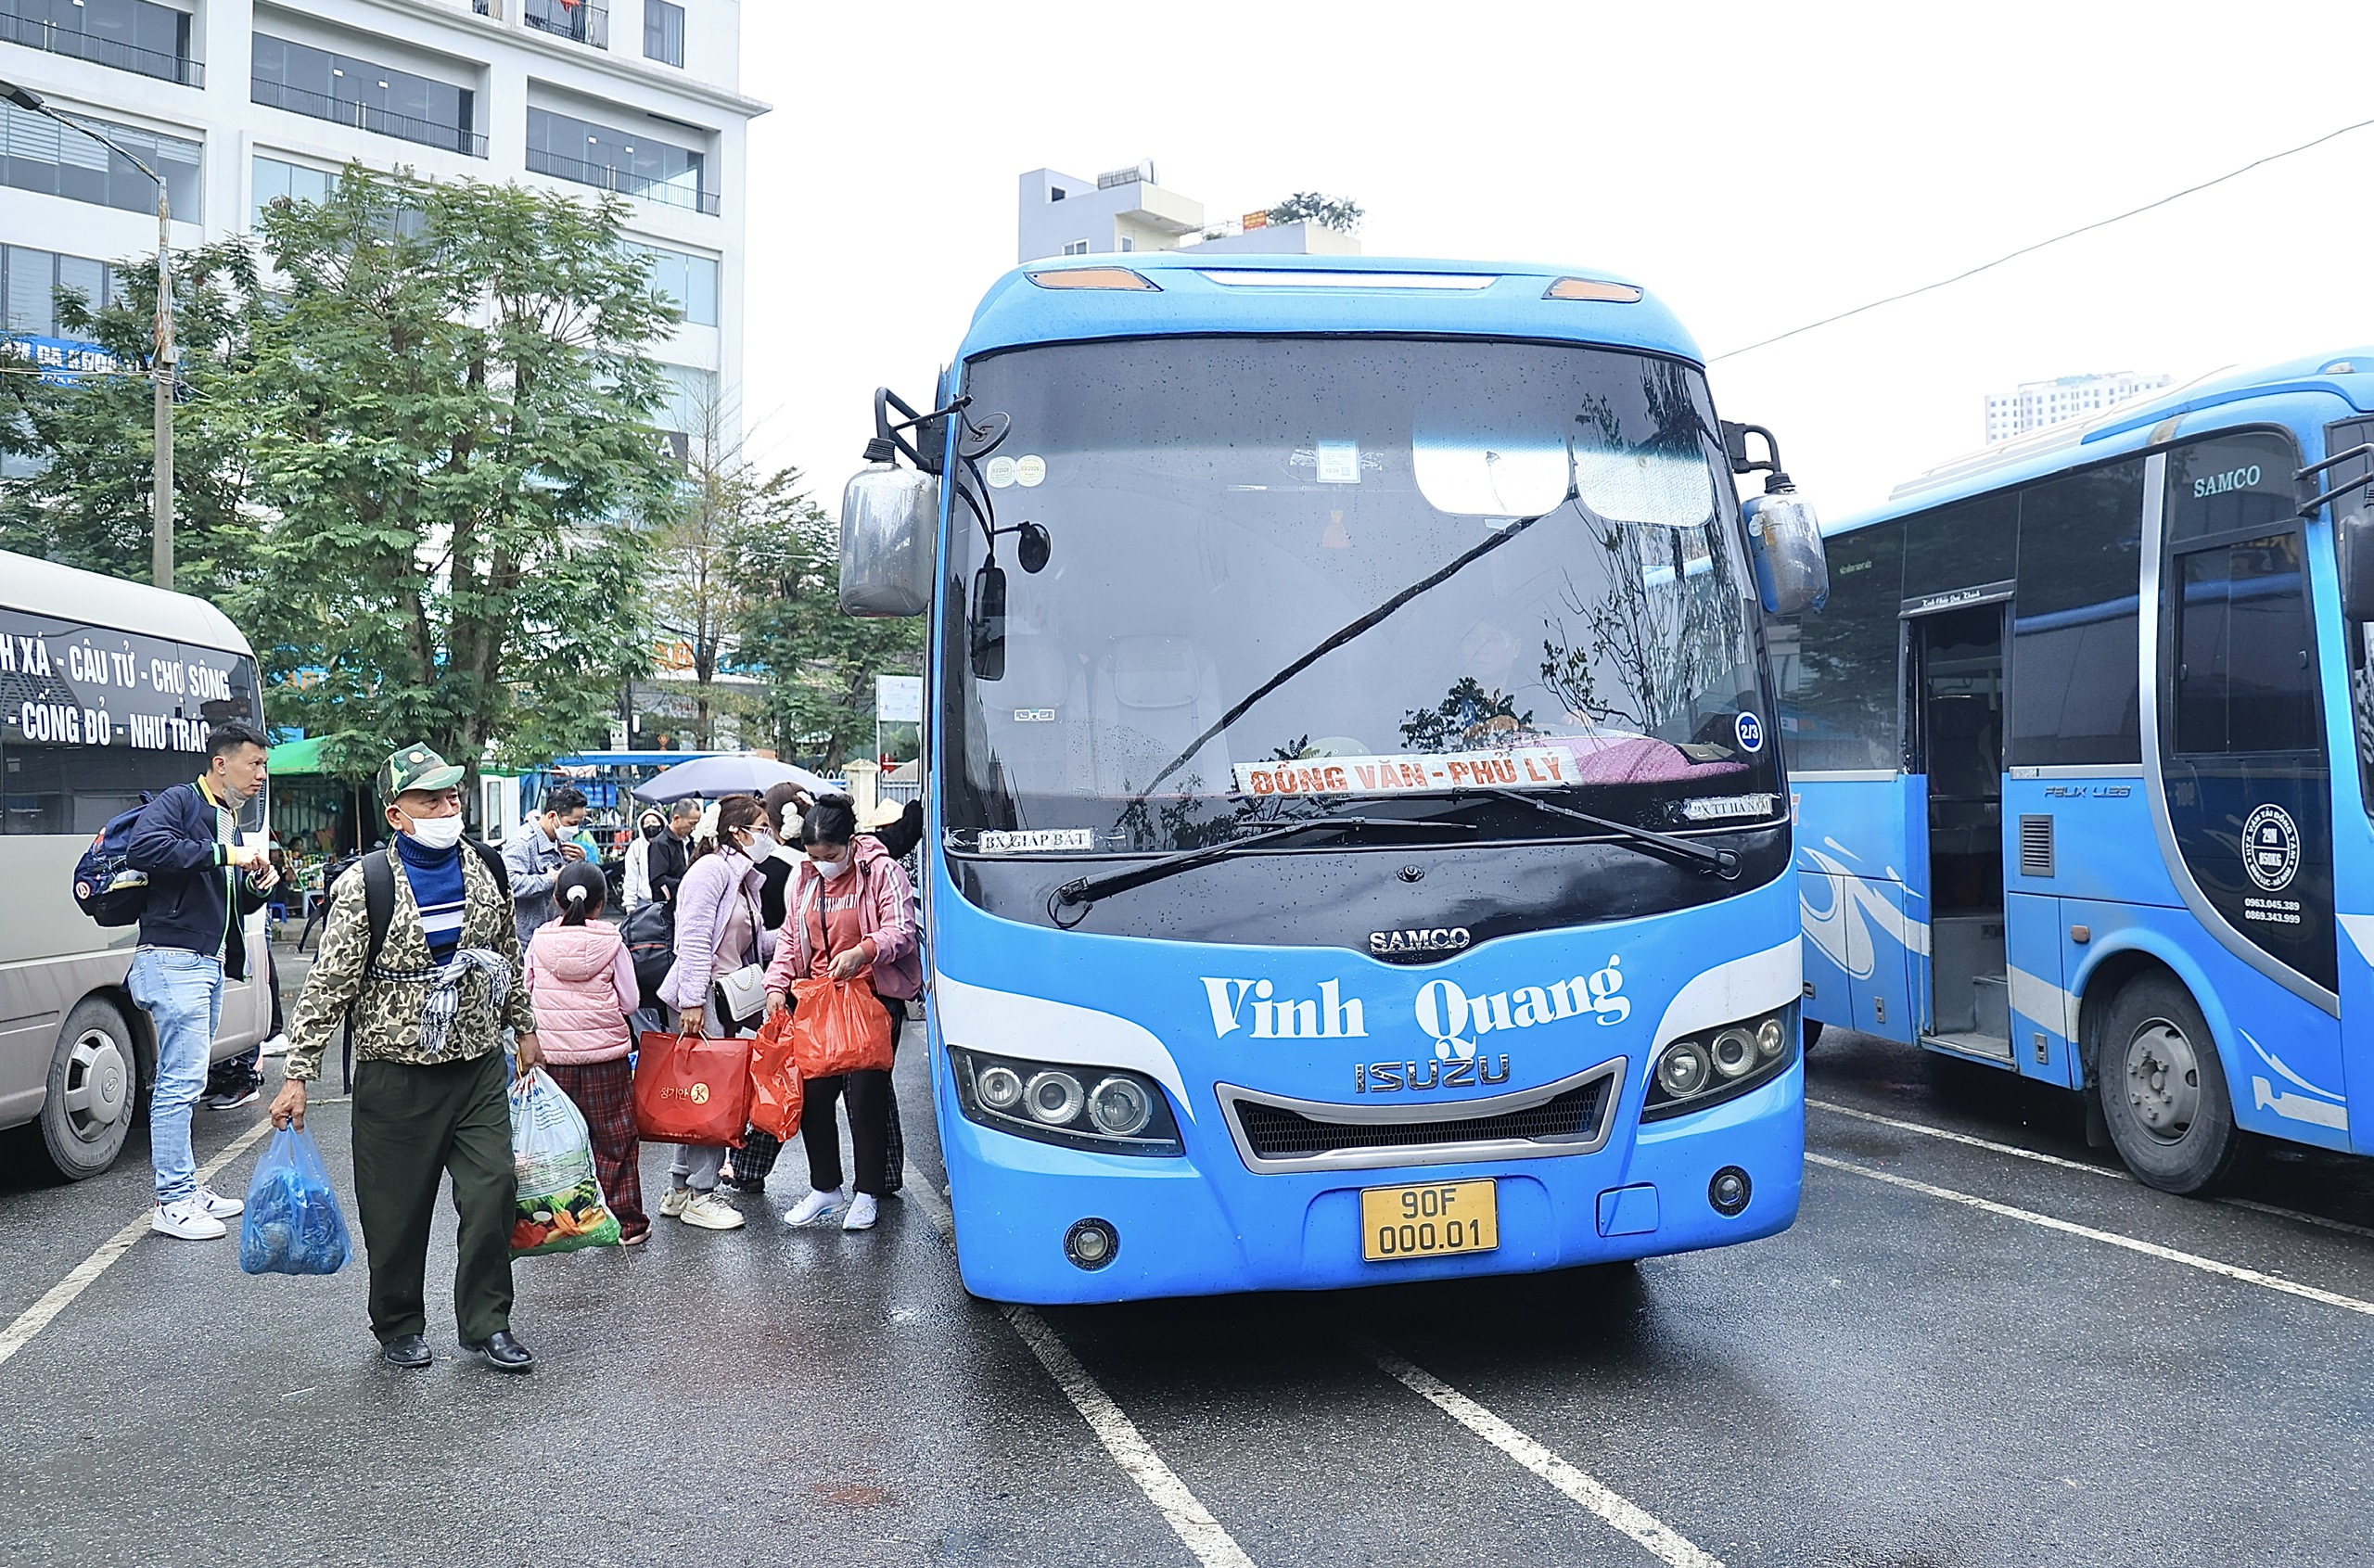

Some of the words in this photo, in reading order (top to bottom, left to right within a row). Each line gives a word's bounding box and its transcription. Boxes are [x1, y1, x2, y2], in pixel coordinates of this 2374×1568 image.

[2194, 465, 2261, 499] SAMCO
[19, 631, 51, 678] XÁ
[69, 638, 109, 685] CÂU
[111, 639, 136, 688] TỬ
[150, 657, 185, 703] CHỢ
[187, 658, 232, 702] SÔNG
[21, 688, 80, 744] CỐNG
[84, 695, 111, 746] ĐỎ
[130, 713, 167, 750] NHƯ
[1740, 724, 1759, 740] 2/3
[1250, 760, 1348, 795] ĐỒNG
[1354, 759, 1429, 790] VĂN
[1446, 751, 1518, 785] PHỦ
[1524, 751, 1563, 782] LÝ
[2044, 784, 2087, 798] FELIX
[986, 835, 1005, 849] BX
[1010, 831, 1049, 848] GIÁP
[1053, 830, 1086, 846] BÁT
[1369, 927, 1471, 953] SAMCO
[1199, 976, 1370, 1039] Vinh
[1414, 953, 1631, 1060] Quang
[1355, 1053, 1511, 1094] ISUZU
[1401, 1188, 1457, 1219] 90F
[1378, 1218, 1480, 1255] 000.01
